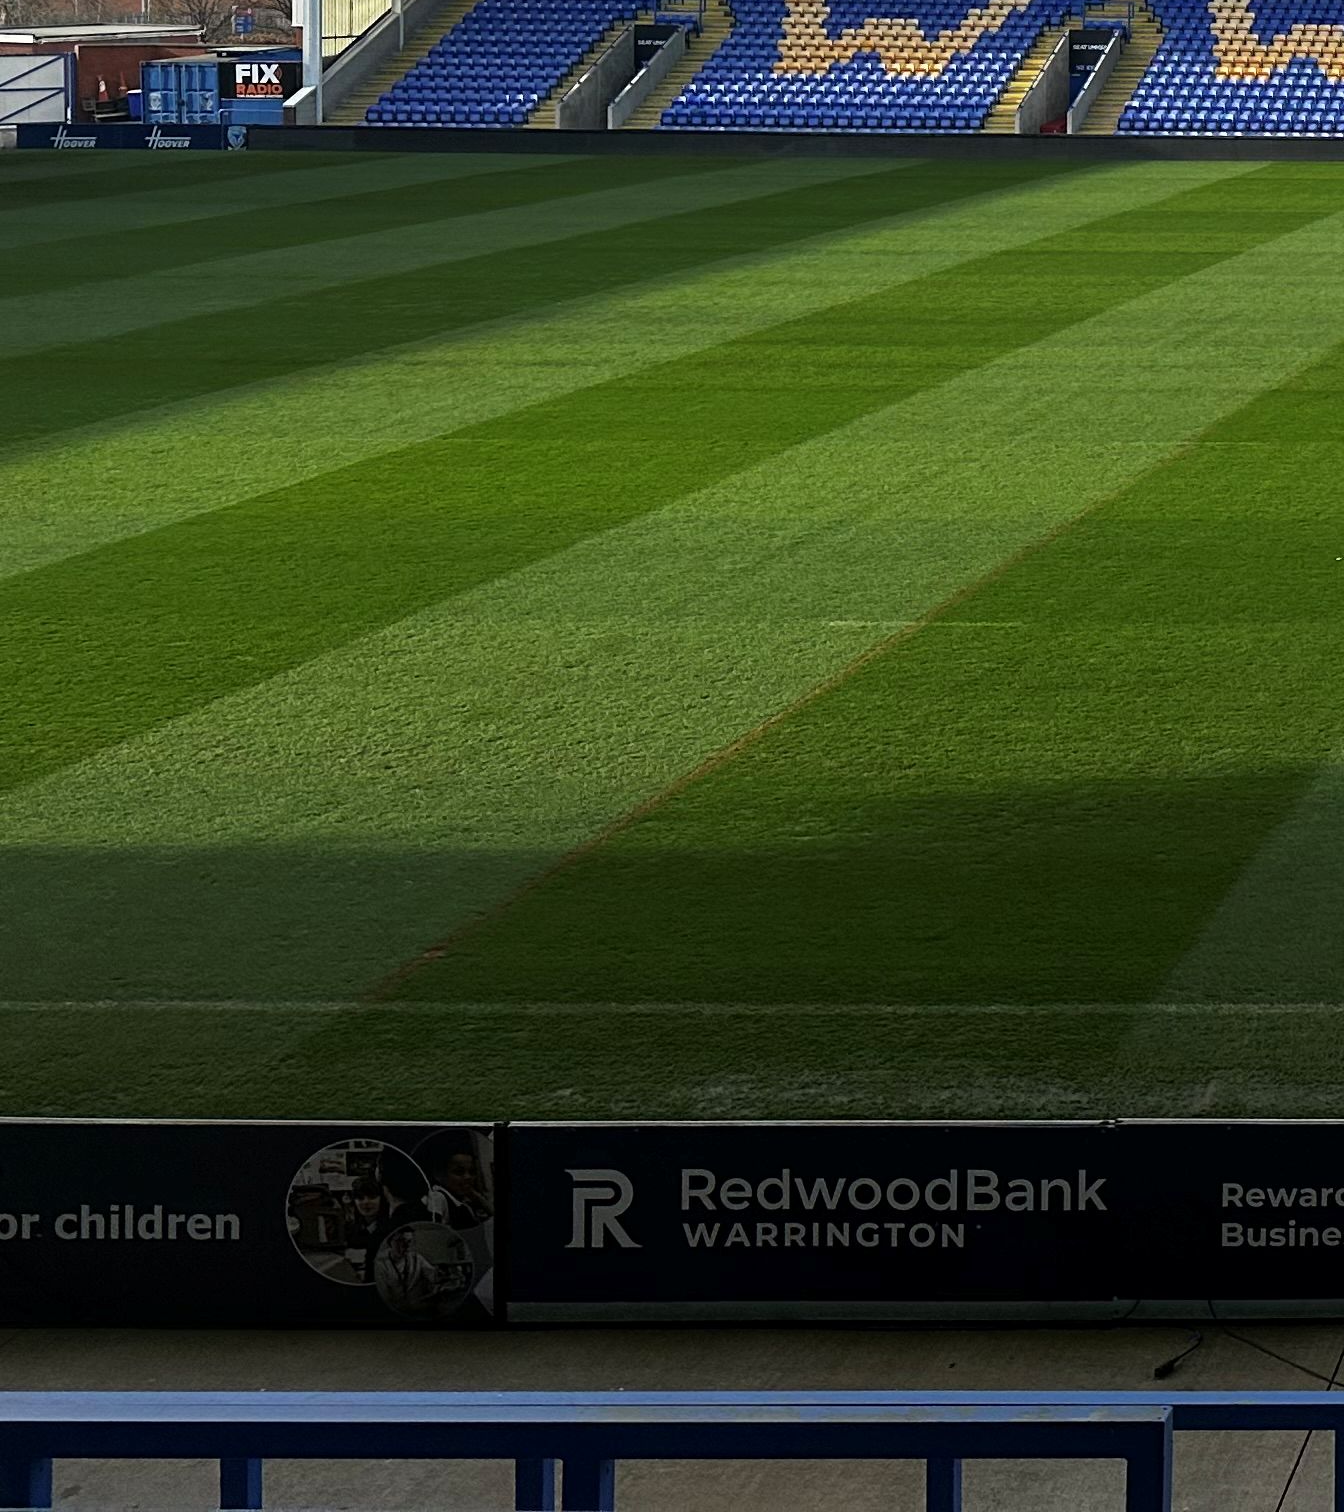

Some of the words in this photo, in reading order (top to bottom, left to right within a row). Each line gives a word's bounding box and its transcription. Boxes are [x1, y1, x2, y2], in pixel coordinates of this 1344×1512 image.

[236, 63, 280, 84] FIX
[237, 84, 284, 96] RADIO
[50, 124, 98, 150] HOOVER
[145, 124, 192, 150] HOOVER
[681, 1168, 1108, 1212] RedwoodBank
[54, 1204, 240, 1241] children
[682, 1222, 965, 1248] WARRINGTON
